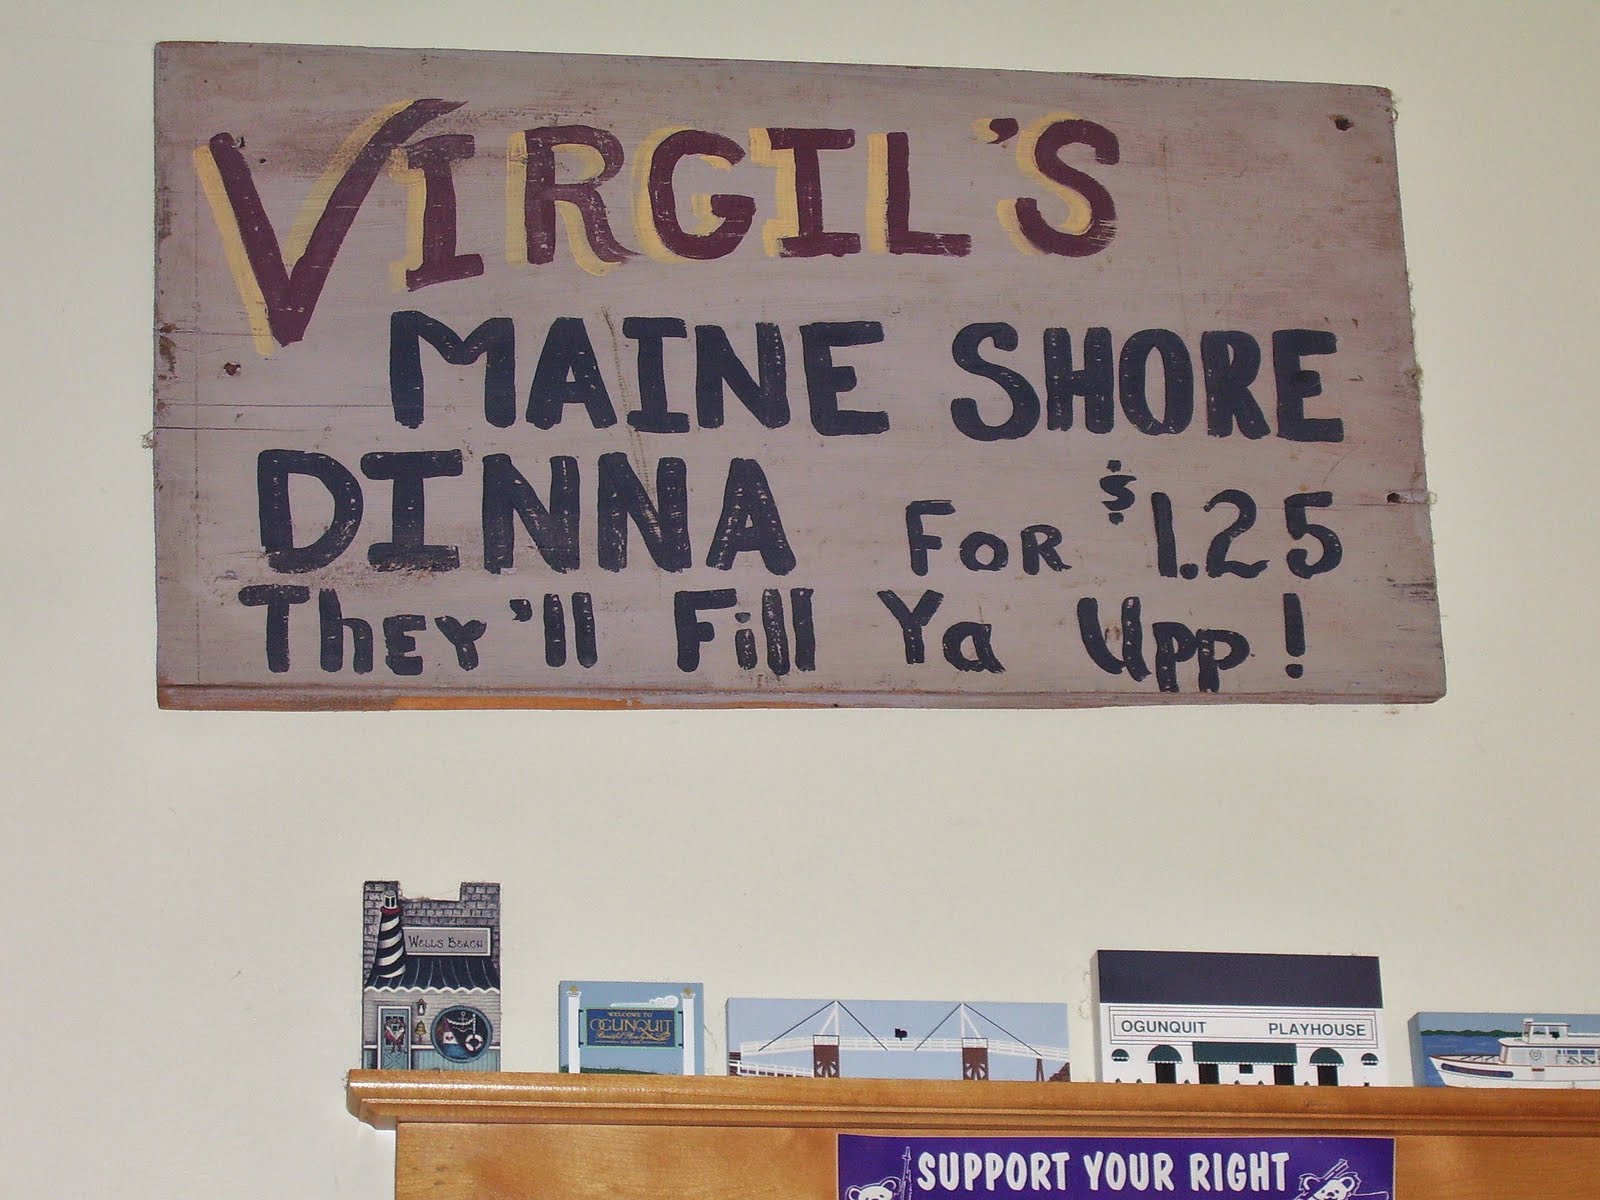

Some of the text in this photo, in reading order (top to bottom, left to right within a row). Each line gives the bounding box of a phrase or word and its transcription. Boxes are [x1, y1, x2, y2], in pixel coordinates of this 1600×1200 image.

[194, 98, 1120, 354] VIRGIL'S
[390, 310, 1345, 442] MAINE SHORE
[257, 449, 796, 574] DINNA
[1100, 459, 1342, 579] $1.25
[674, 588, 814, 676] Fill
[878, 589, 1005, 673] Ya
[589, 1018, 672, 1039] OGUNQUIT
[1121, 1020, 1366, 1037] OGUNQUIT PLAYHOUSE
[917, 1151, 1291, 1192] SUPPORT YOUR RIGHT
